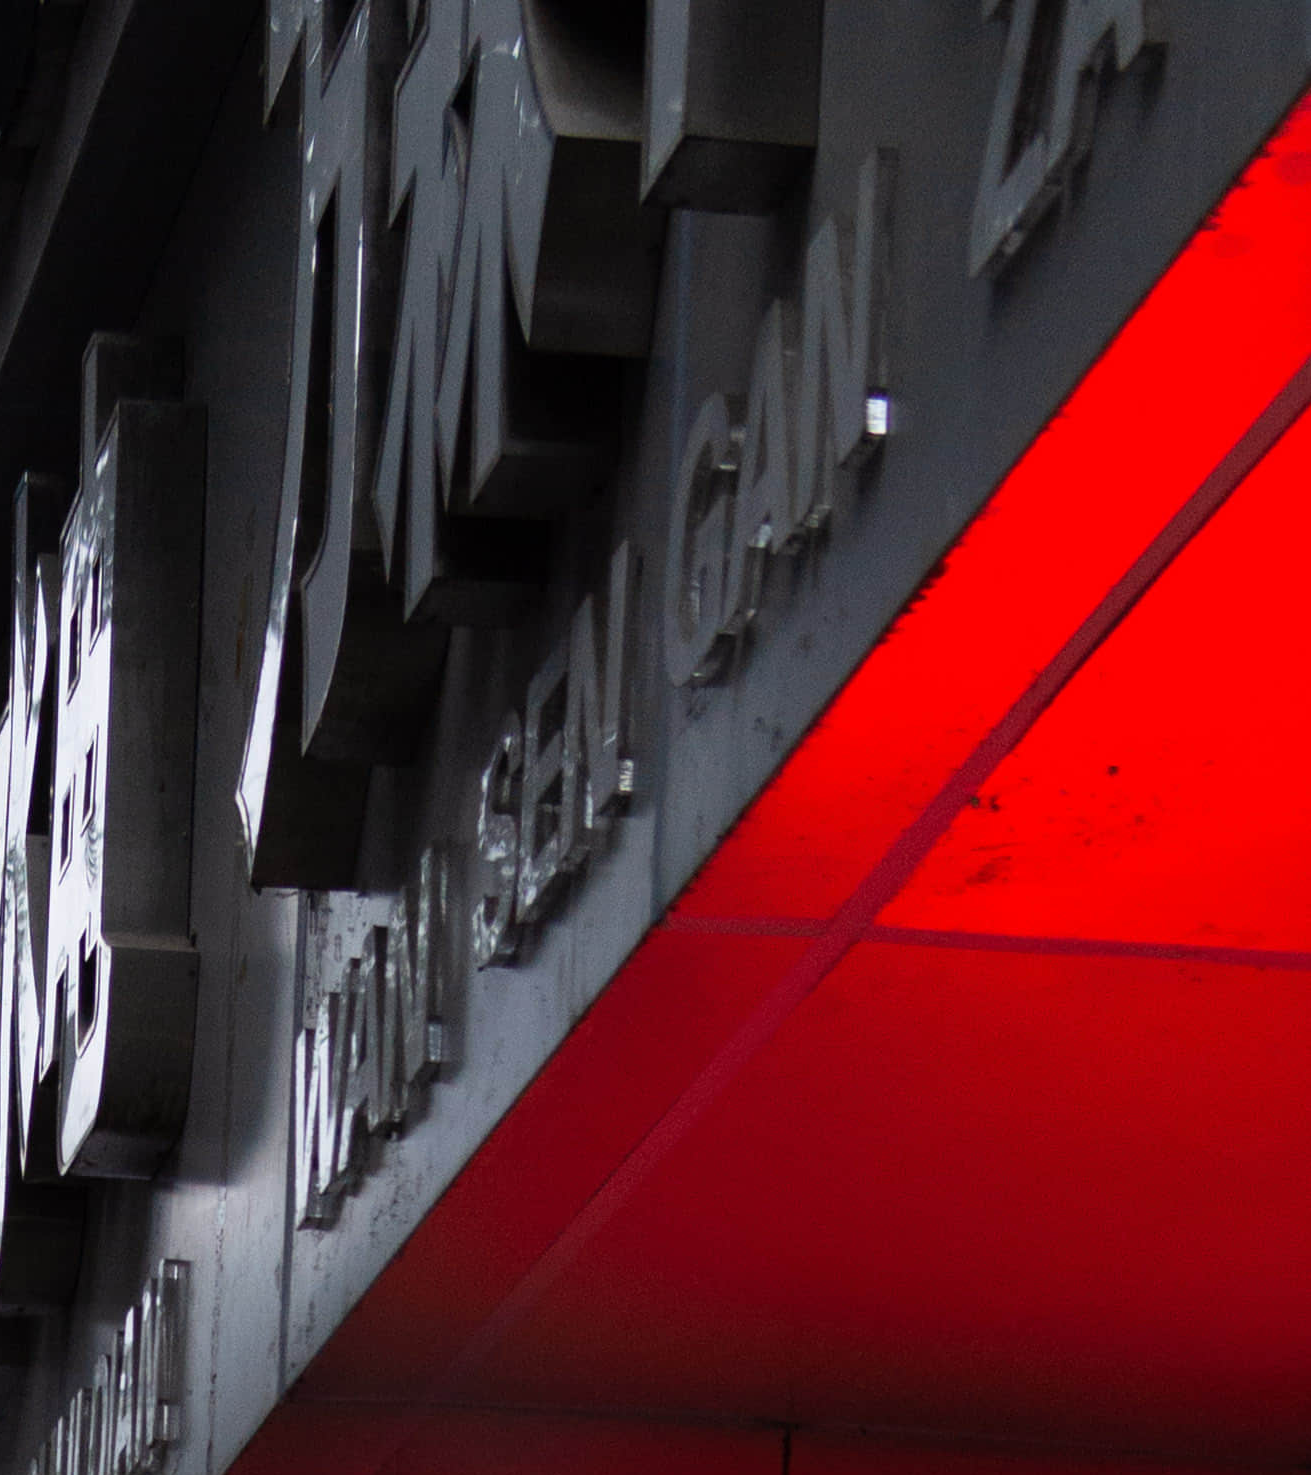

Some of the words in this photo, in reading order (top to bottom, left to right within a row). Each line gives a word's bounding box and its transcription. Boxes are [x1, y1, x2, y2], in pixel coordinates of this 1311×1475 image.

[294, 848, 448, 1230] WAN
[472, 541, 640, 970] SEN
[666, 148, 893, 690] GAN
